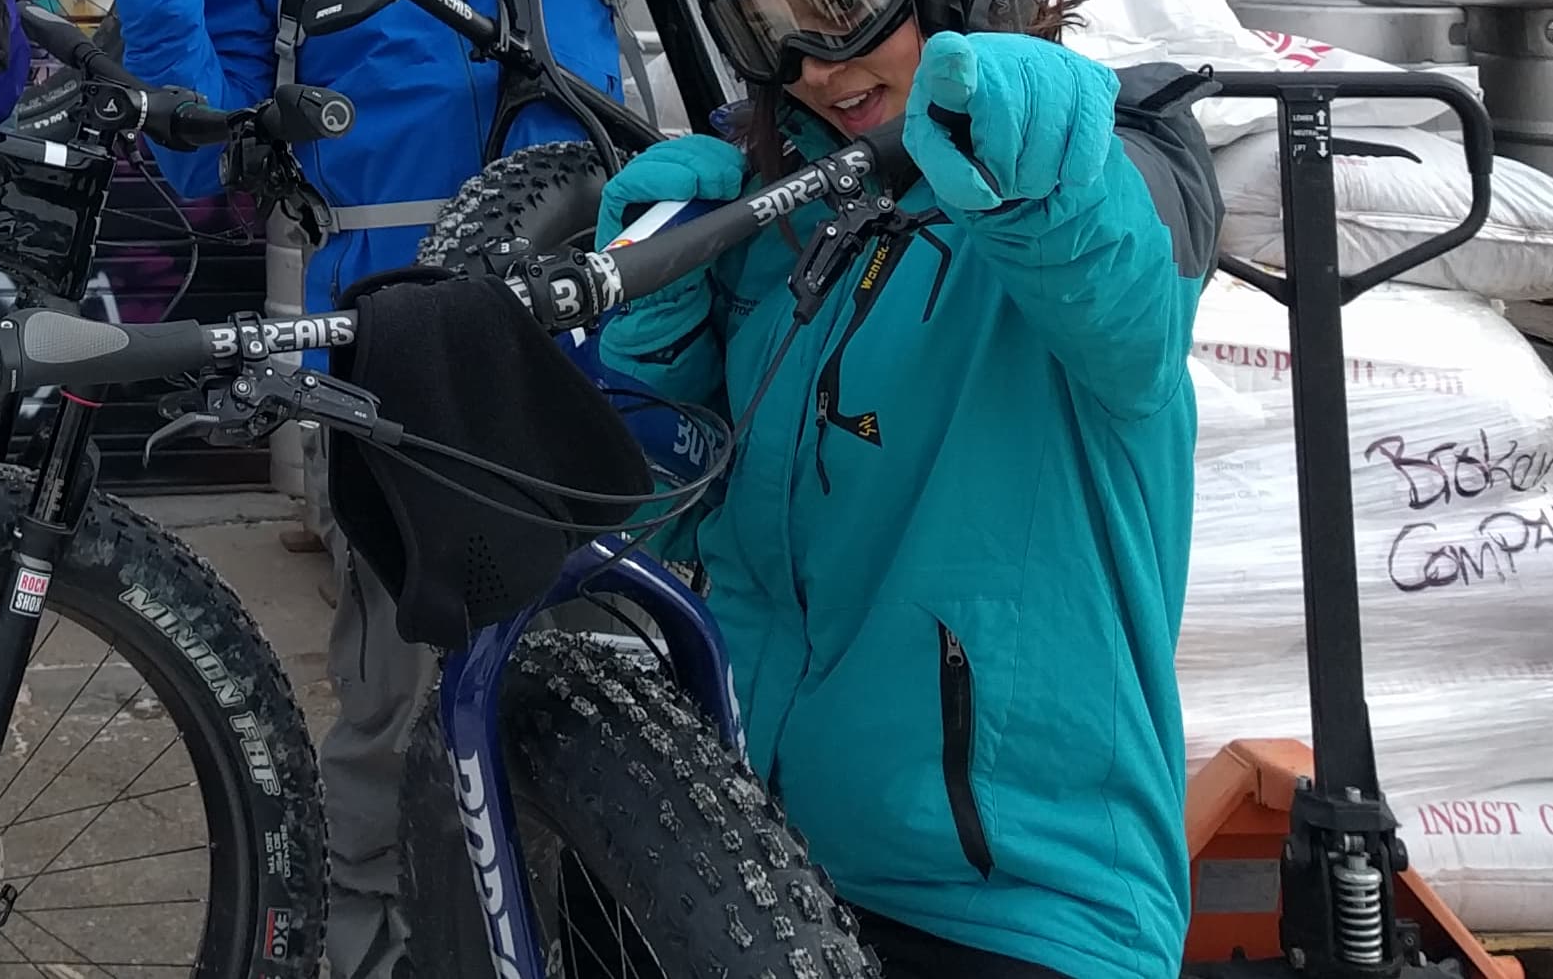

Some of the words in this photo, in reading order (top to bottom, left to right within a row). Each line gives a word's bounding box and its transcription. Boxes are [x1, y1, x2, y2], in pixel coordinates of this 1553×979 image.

[20, 574, 48, 593] ROCK
[14, 592, 43, 613] SHOX
[118, 582, 246, 708] MINION
[1417, 800, 1524, 836] INSIST
[272, 913, 290, 958] EXO
